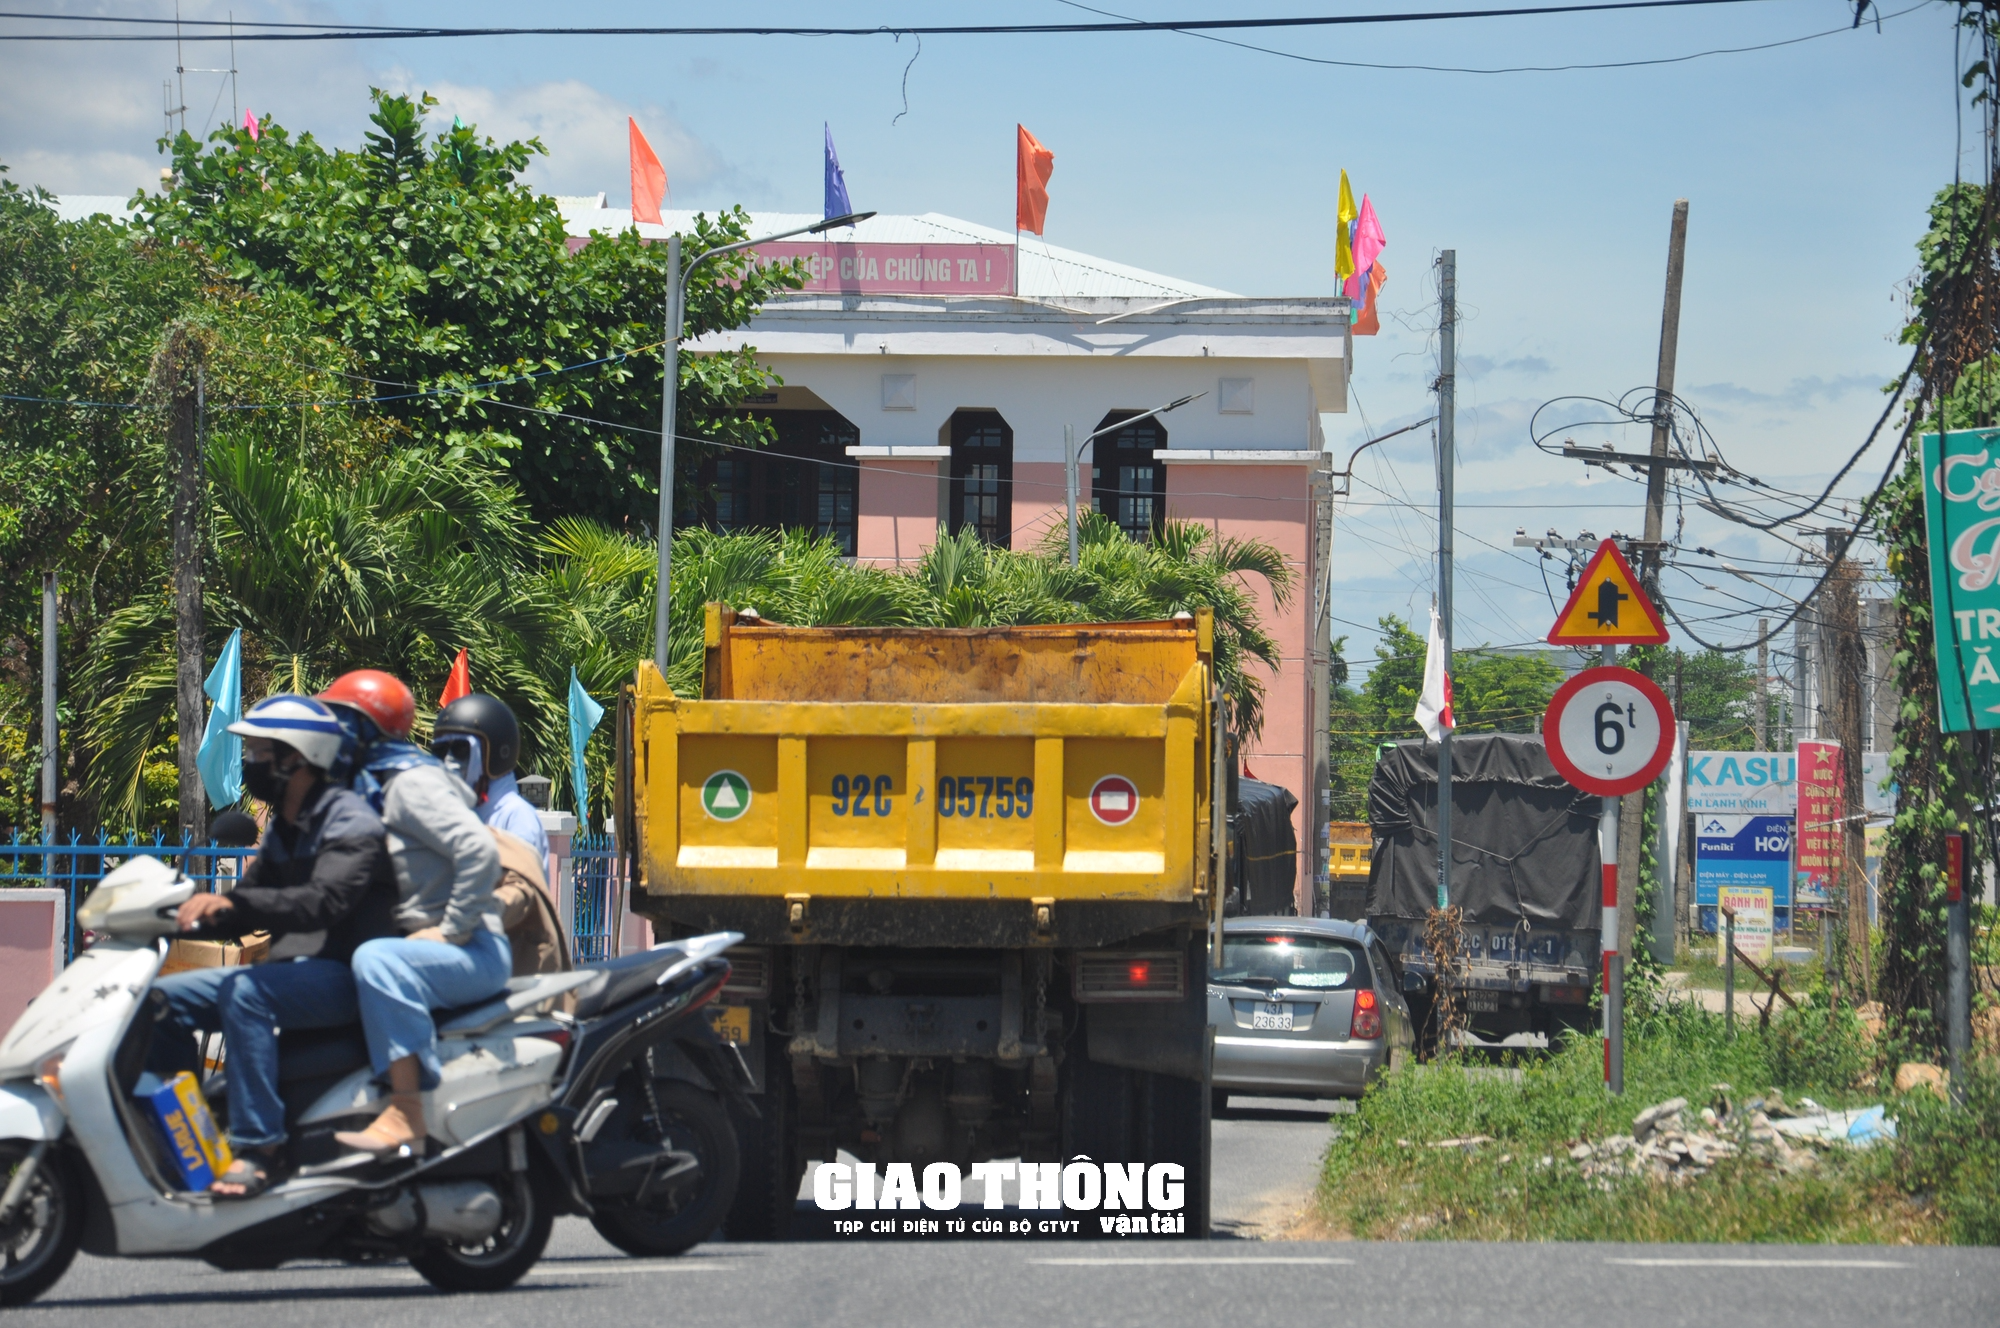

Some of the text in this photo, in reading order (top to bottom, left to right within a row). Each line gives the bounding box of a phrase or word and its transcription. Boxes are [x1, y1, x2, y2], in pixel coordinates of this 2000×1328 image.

[840, 250, 879, 280] CỦA
[885, 250, 951, 282] CHÚNG
[957, 258, 978, 282] TA
[831, 773, 1035, 820] 92C 057.59
[1701, 842, 1734, 851] Funiki
[1263, 1003, 1284, 1015] 43A
